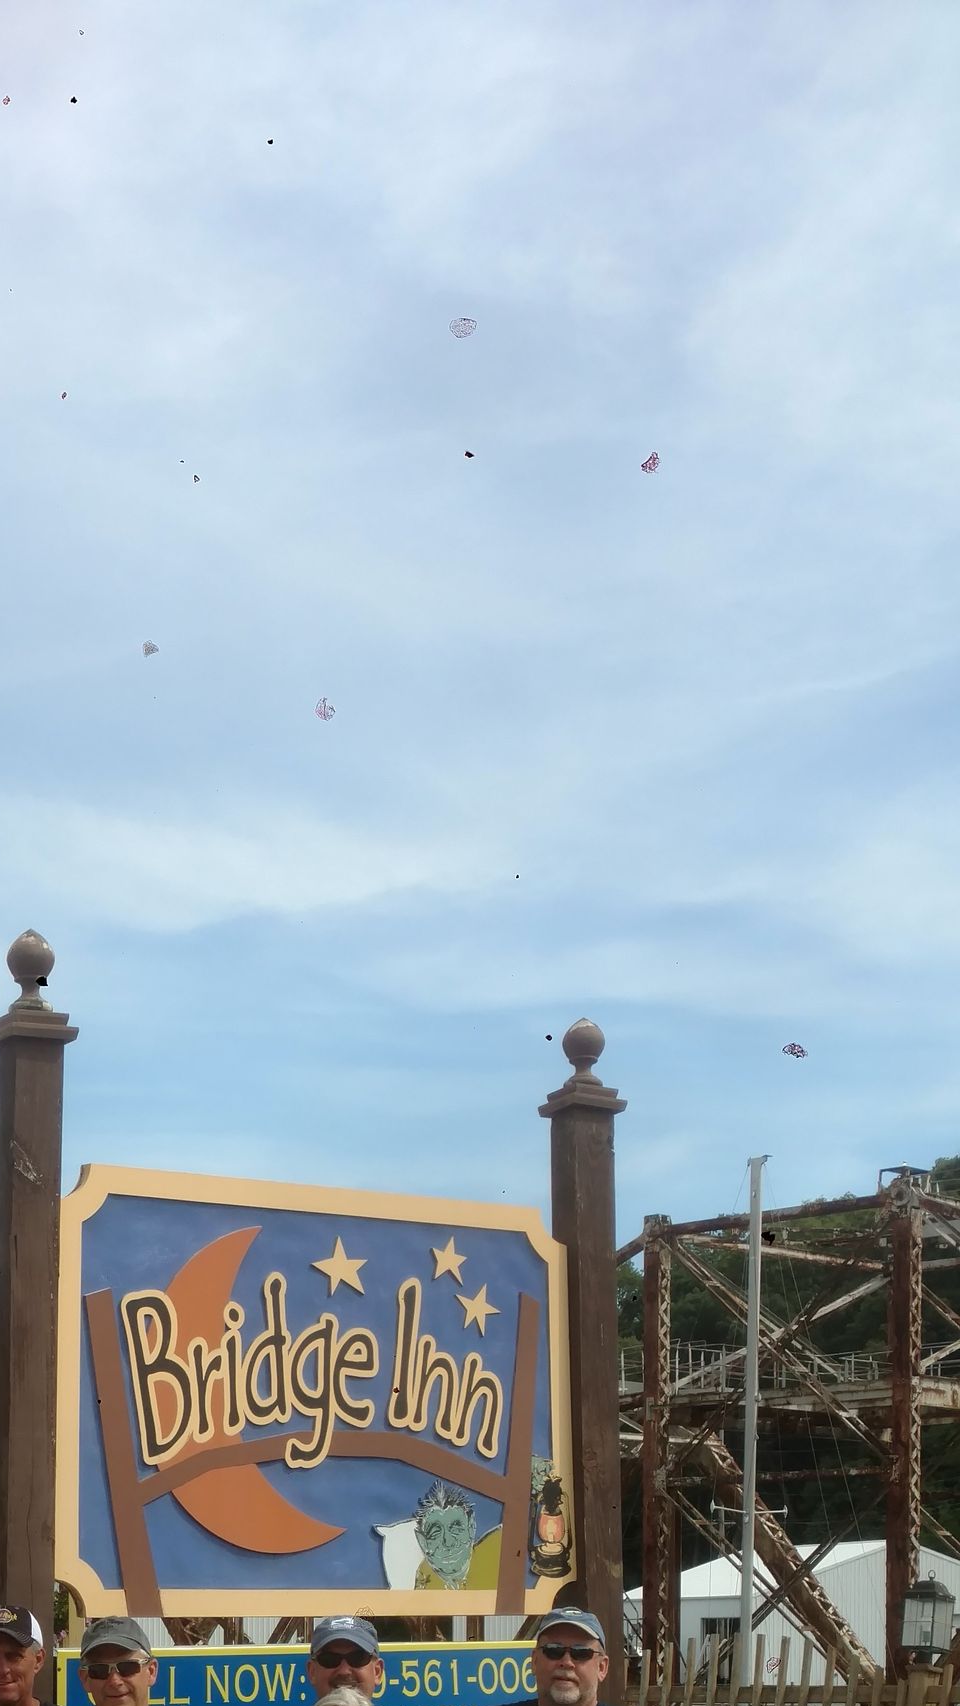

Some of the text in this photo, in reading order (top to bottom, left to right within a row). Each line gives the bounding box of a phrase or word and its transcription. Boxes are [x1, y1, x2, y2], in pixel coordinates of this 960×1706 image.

[121, 1271, 504, 1469] Bridge Inn
[206, 1663, 306, 1704] NOW:
